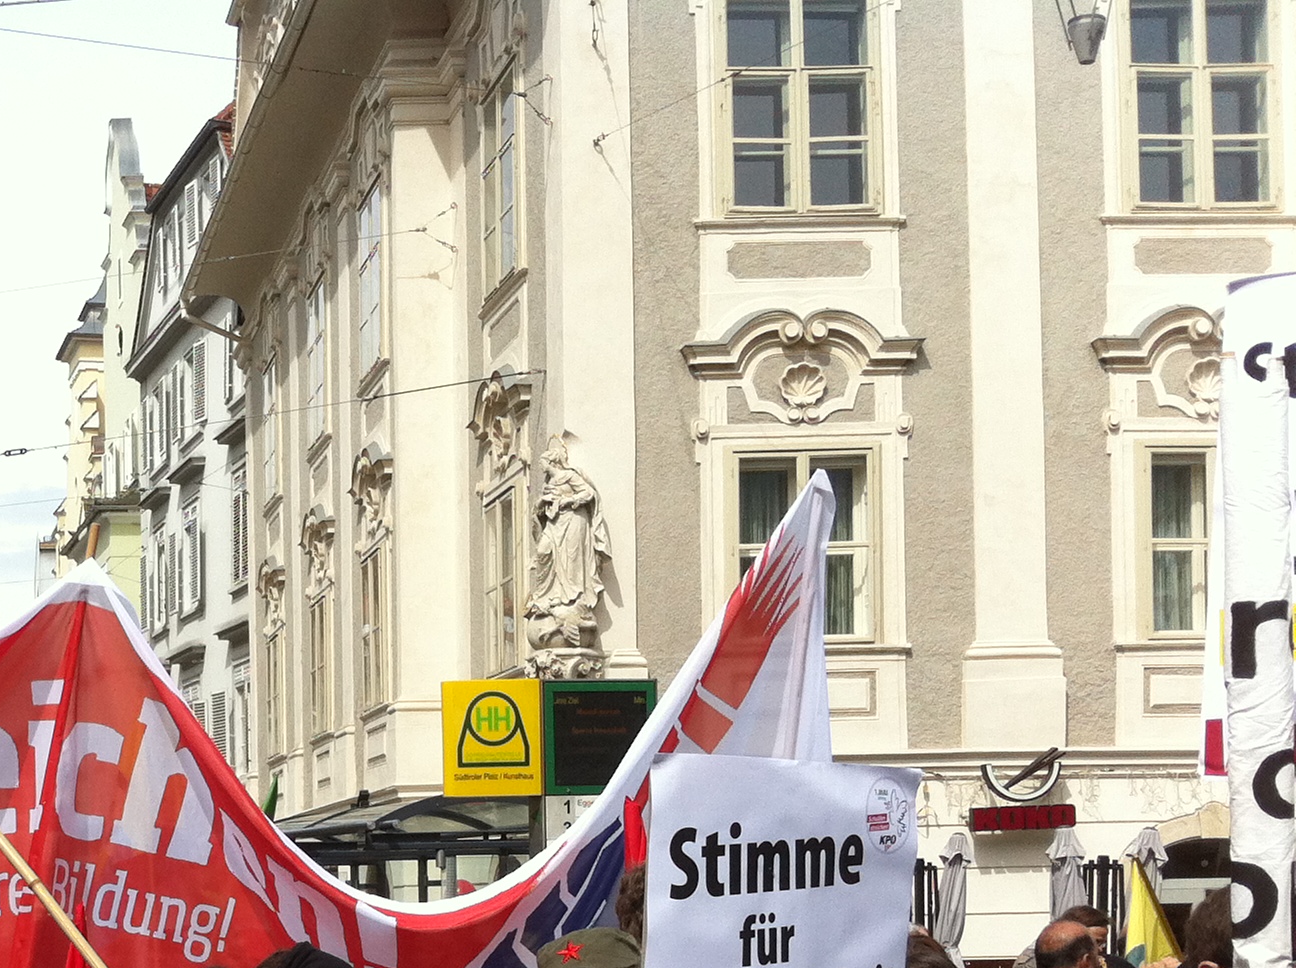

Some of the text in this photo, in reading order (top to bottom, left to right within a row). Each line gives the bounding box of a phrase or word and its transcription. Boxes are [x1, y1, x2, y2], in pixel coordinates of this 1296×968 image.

[563, 799, 571, 815] 1
[669, 822, 865, 900] Stimme
[739, 912, 795, 967] für
